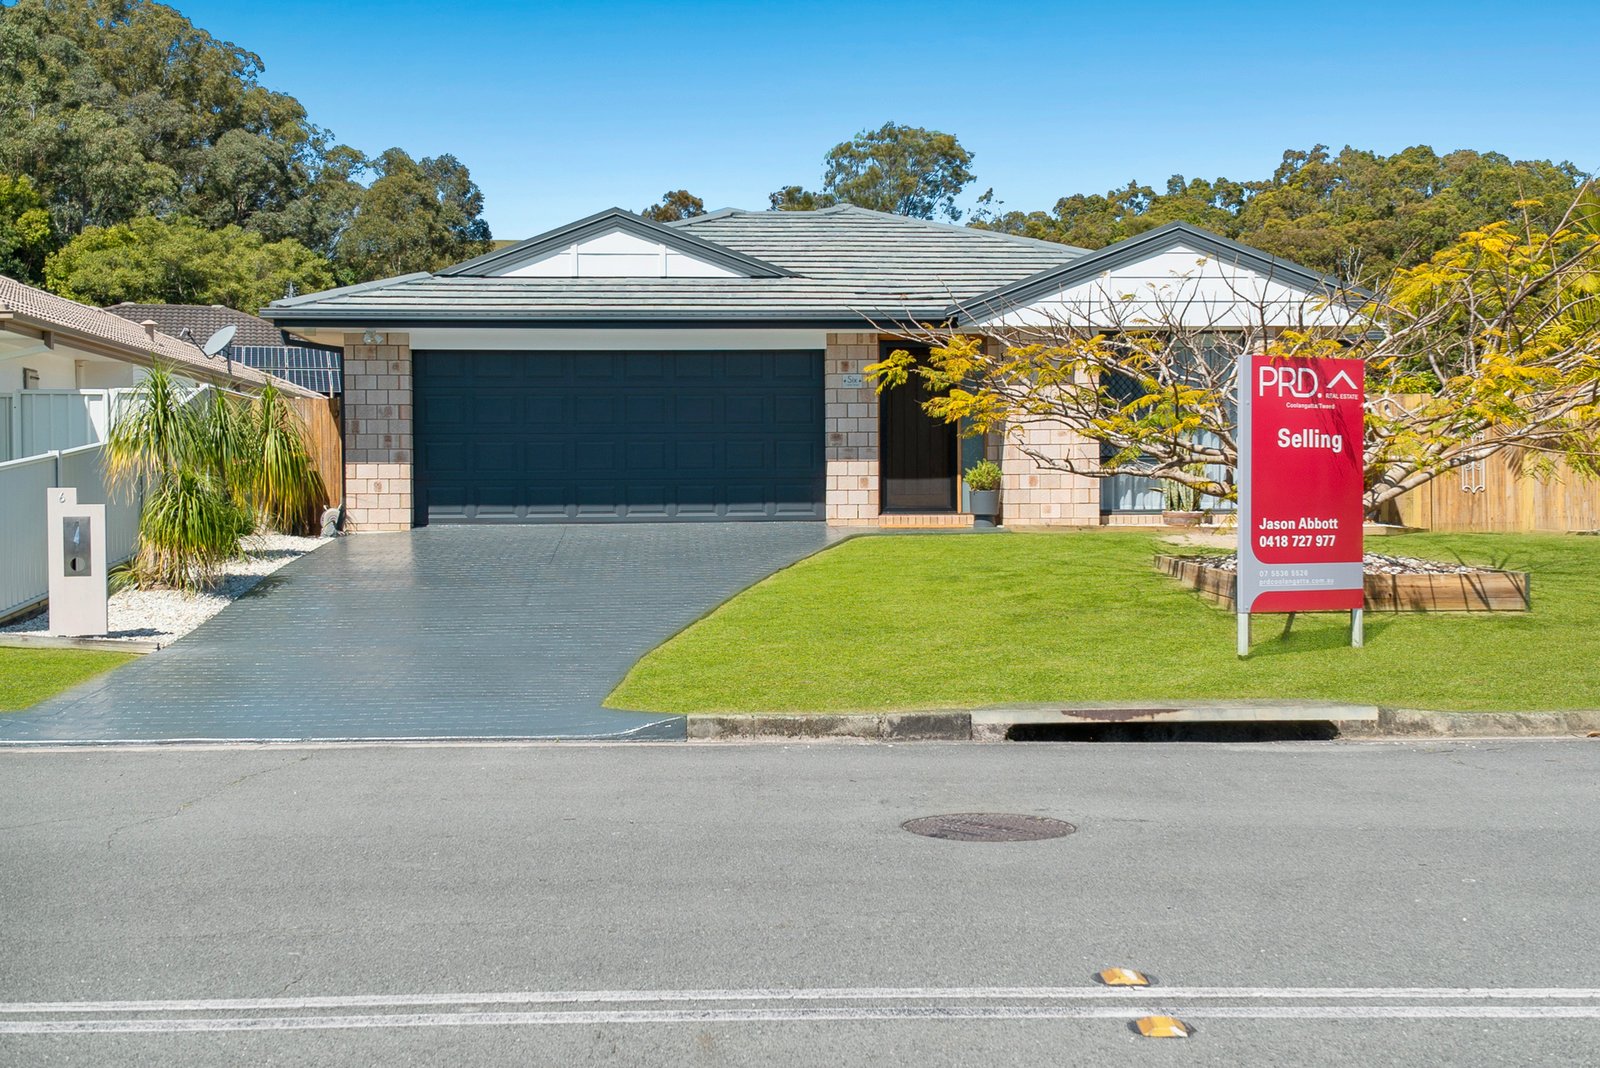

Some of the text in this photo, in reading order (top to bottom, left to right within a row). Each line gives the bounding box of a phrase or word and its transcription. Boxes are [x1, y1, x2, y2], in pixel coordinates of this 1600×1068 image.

[1277, 428, 1342, 453] Selling
[59, 492, 66, 504] 6
[1259, 518, 1338, 530] Jason Abbott
[1259, 535, 1336, 548] 0418 727 977
